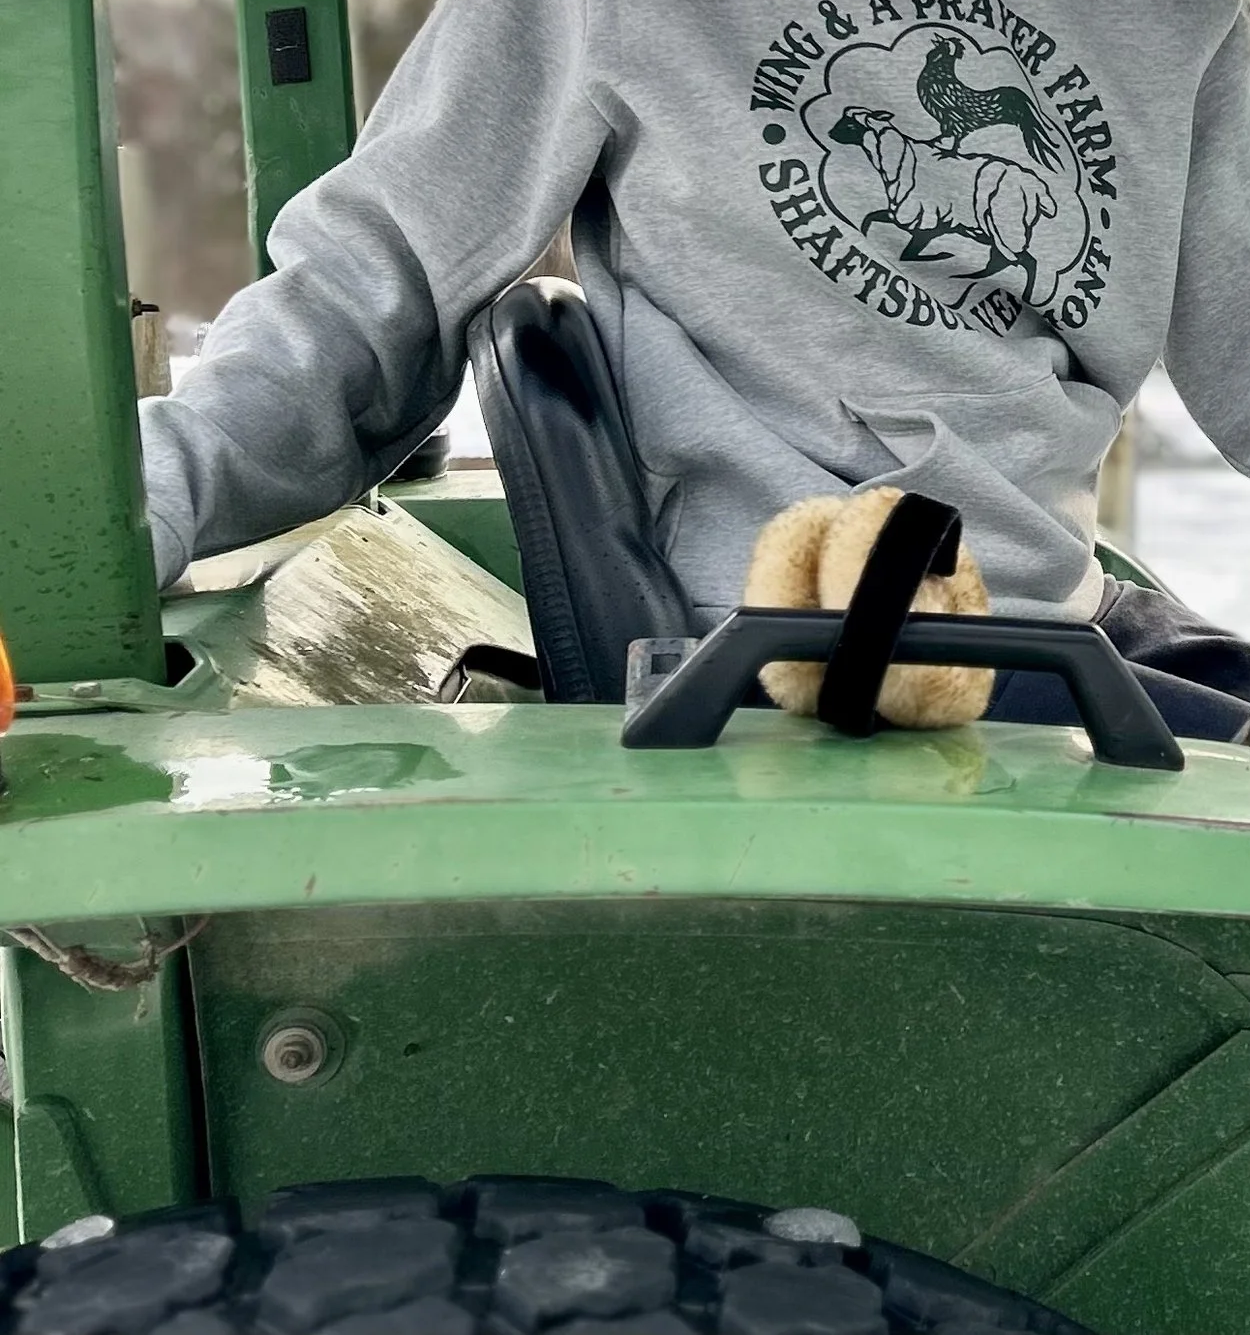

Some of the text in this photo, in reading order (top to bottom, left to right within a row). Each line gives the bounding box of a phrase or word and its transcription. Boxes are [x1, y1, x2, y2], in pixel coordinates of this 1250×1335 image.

[750, 21, 825, 112] WING
[817, 0, 859, 40] &
[1043, 64, 1118, 200] FARM
